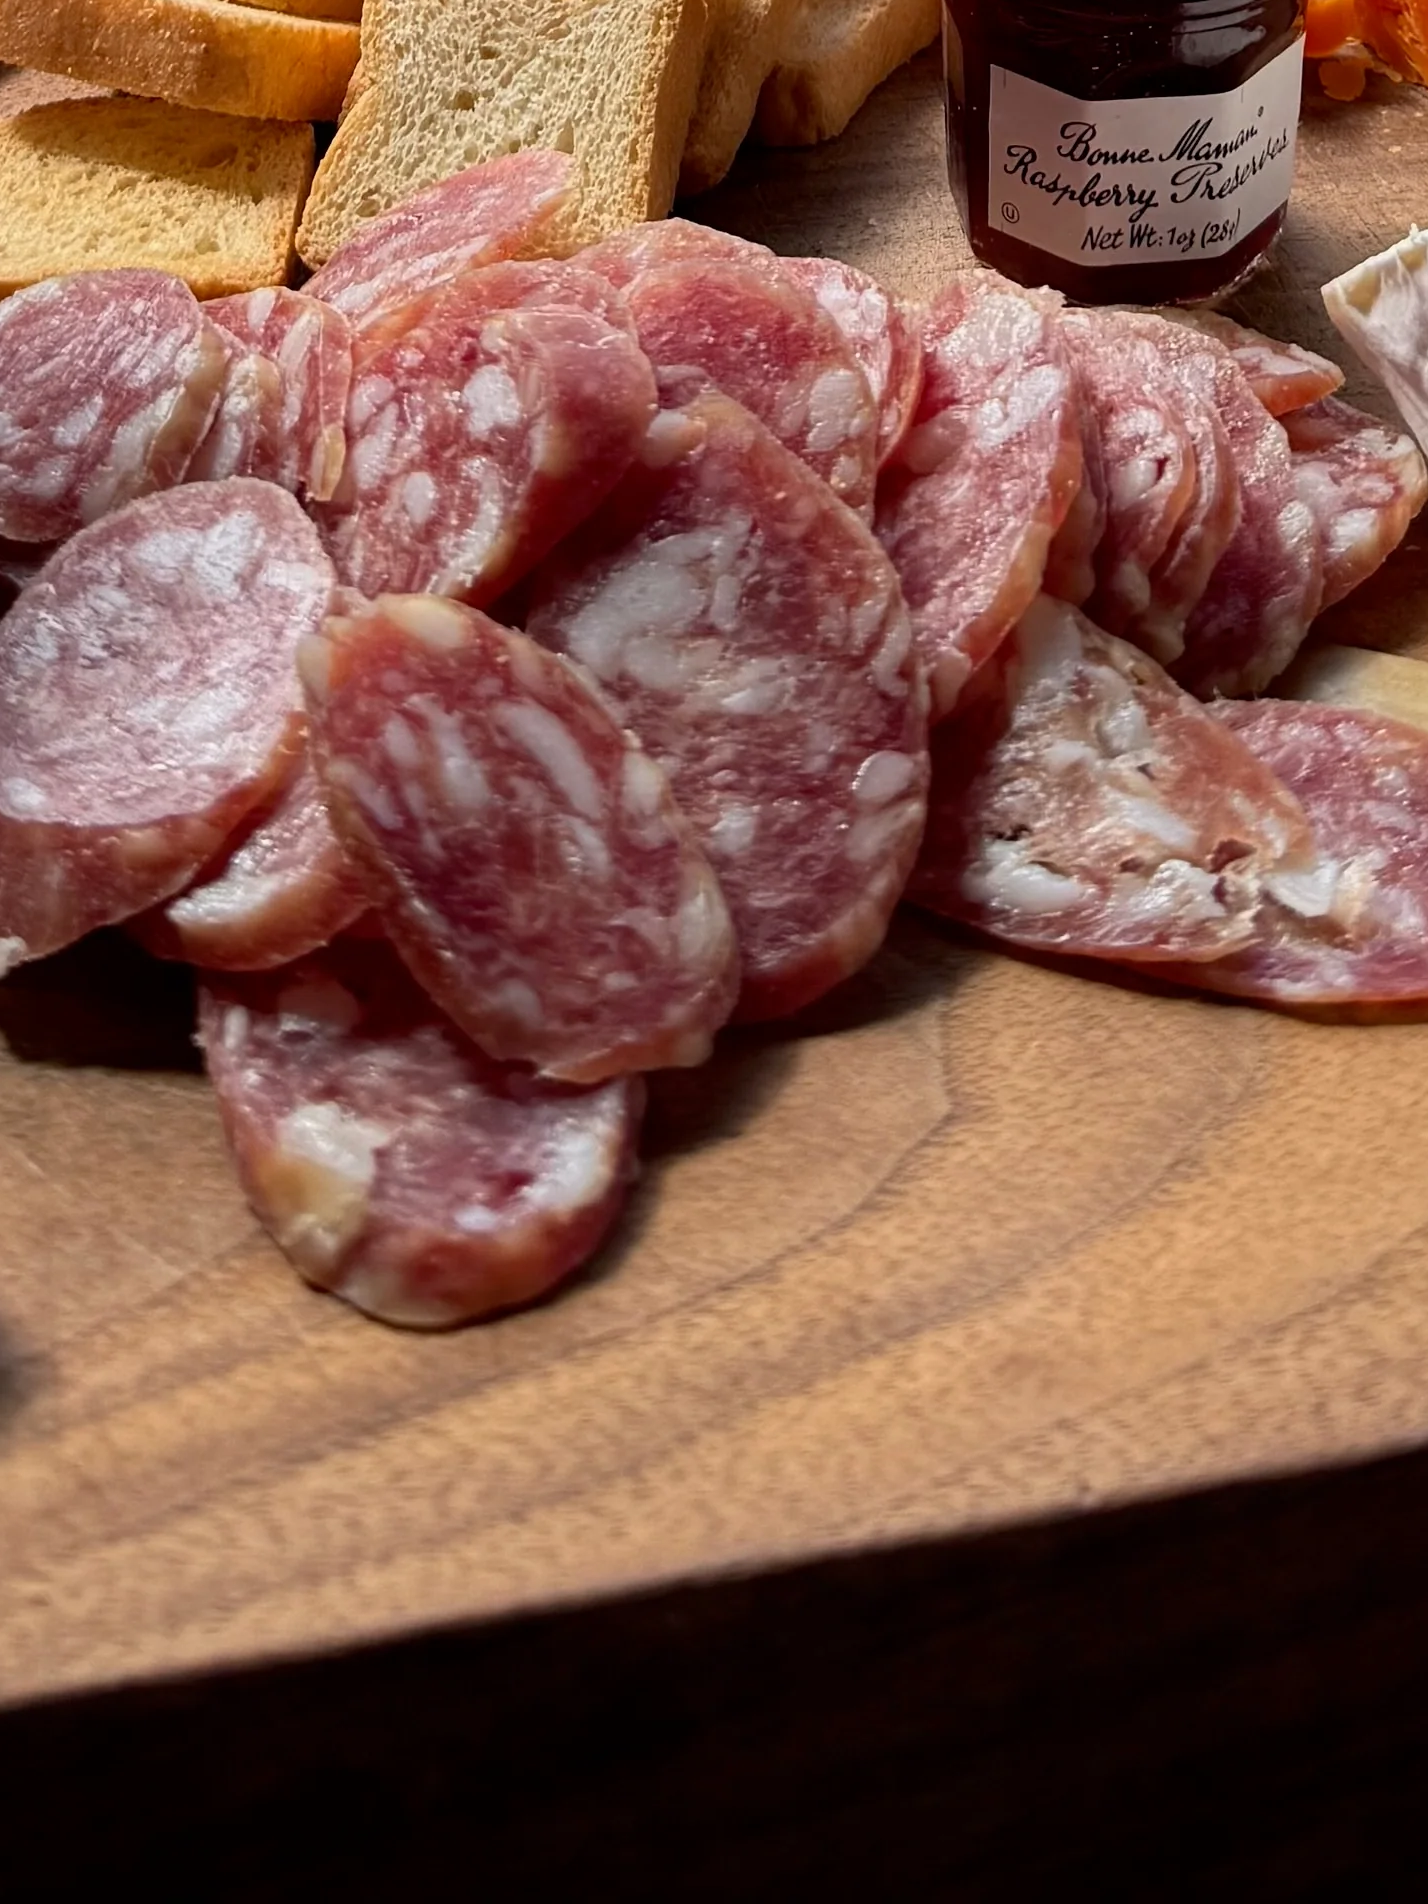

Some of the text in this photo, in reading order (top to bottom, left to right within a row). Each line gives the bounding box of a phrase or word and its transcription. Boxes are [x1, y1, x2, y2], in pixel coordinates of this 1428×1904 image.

[1056, 121, 1154, 167] Bonne
[1004, 128, 1290, 223] Raspberry Preserves
[1080, 225, 1124, 251] Net
[1128, 222, 1163, 249] Wt:
